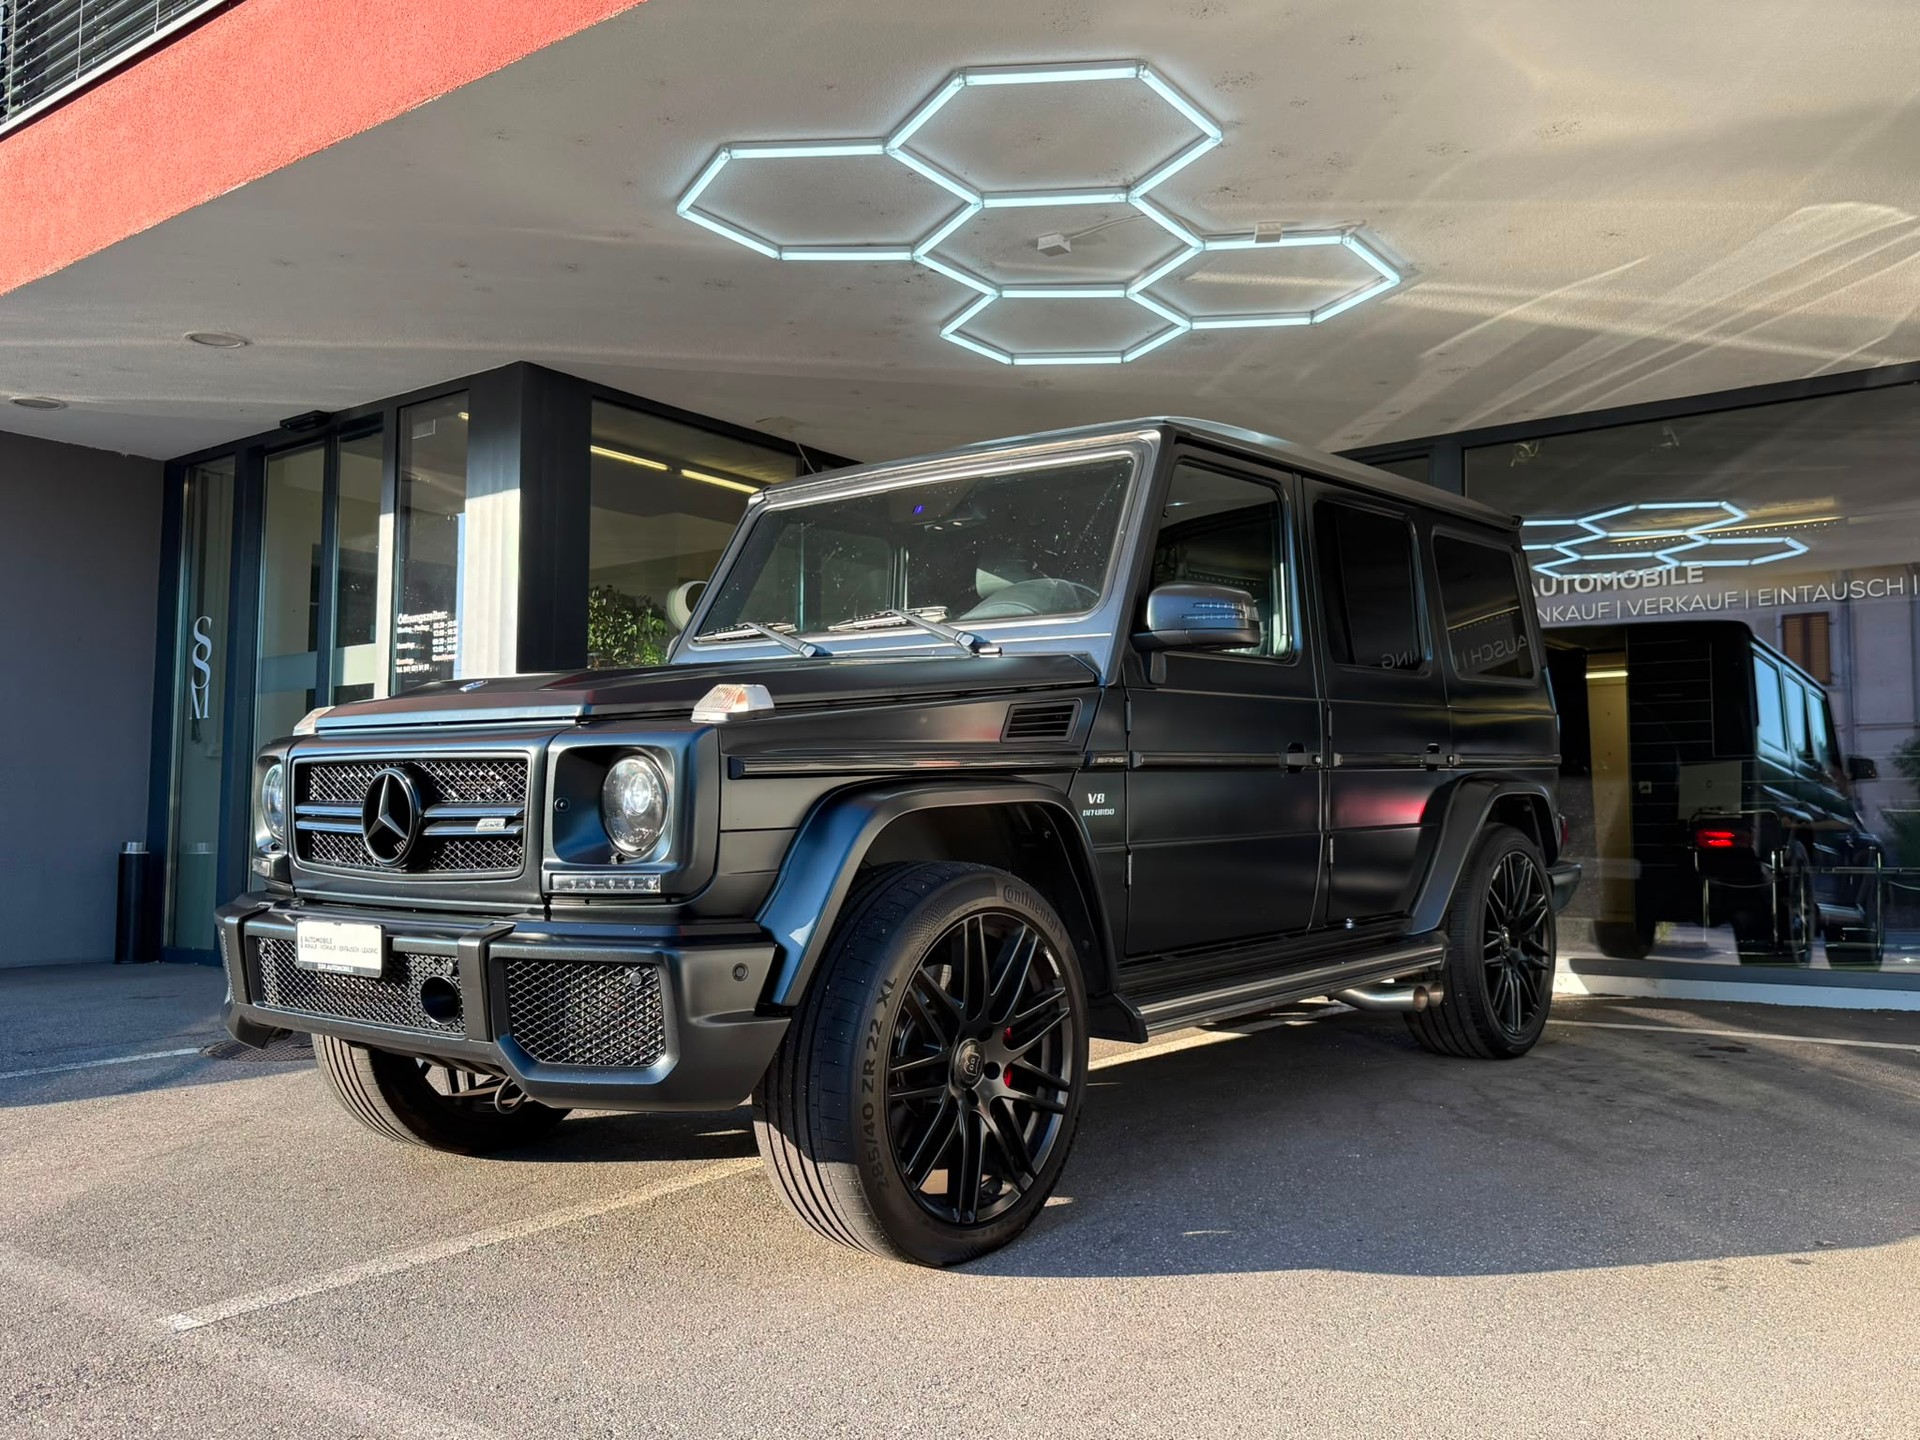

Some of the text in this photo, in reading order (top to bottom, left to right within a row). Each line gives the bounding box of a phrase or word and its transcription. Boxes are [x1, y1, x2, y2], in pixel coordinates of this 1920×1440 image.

[1627, 591, 1738, 616] VERKAUF
[1758, 577, 1904, 606] EINTAUSCH
[1082, 808, 1115, 816] BITURBO
[1087, 793, 1105, 804] V8
[876, 975, 898, 1008] XL
[866, 1018, 883, 1051] 22
[862, 1058, 876, 1094] ZR
